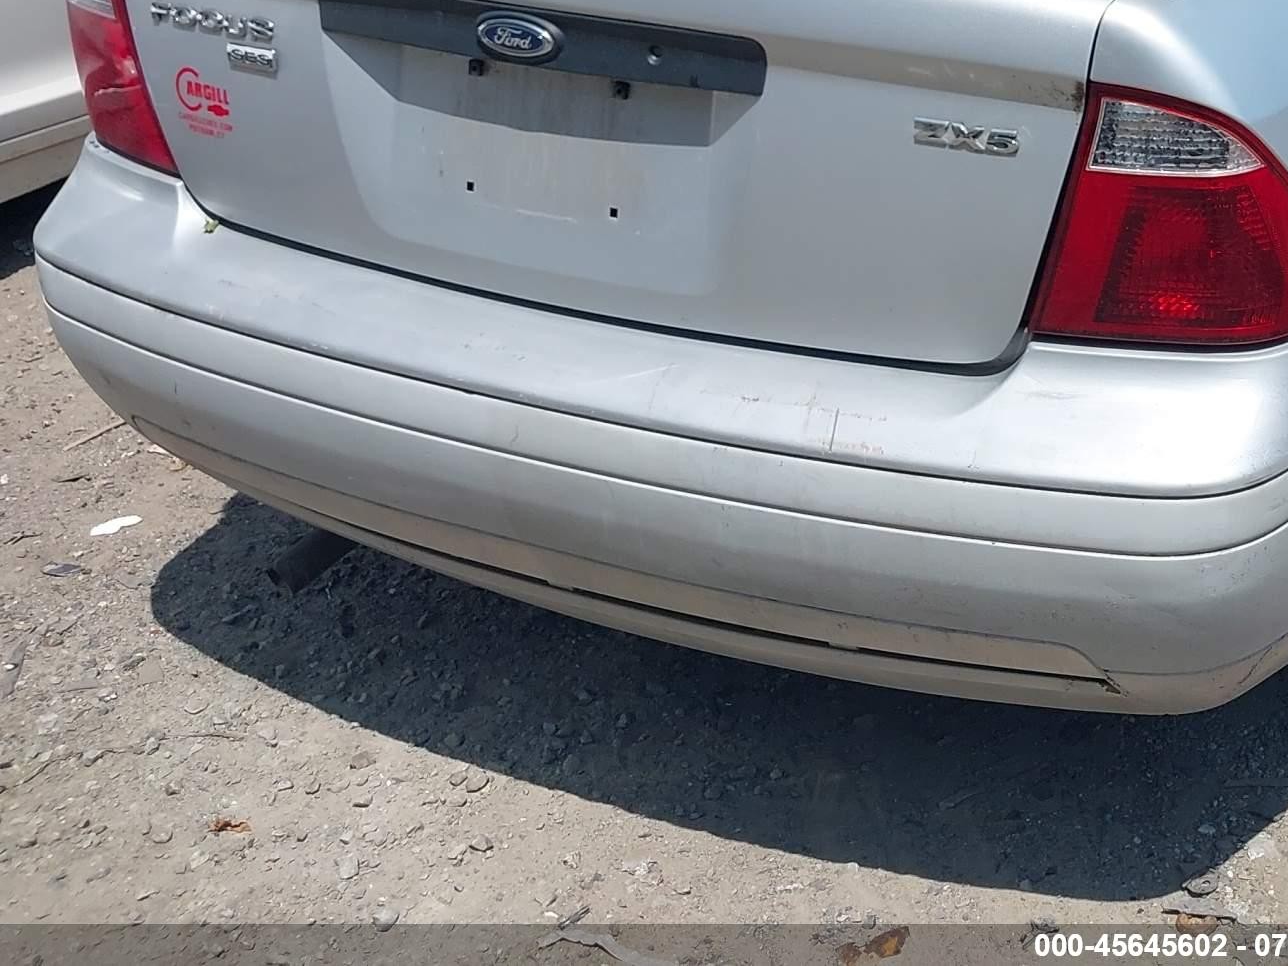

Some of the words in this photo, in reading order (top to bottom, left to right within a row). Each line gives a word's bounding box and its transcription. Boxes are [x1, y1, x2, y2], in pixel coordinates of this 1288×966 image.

[151, 2, 274, 43] FOCUS
[494, 26, 533, 49] Ford
[231, 48, 273, 69] SES
[176, 67, 229, 111] CARGILL
[913, 116, 1020, 157] ZX5
